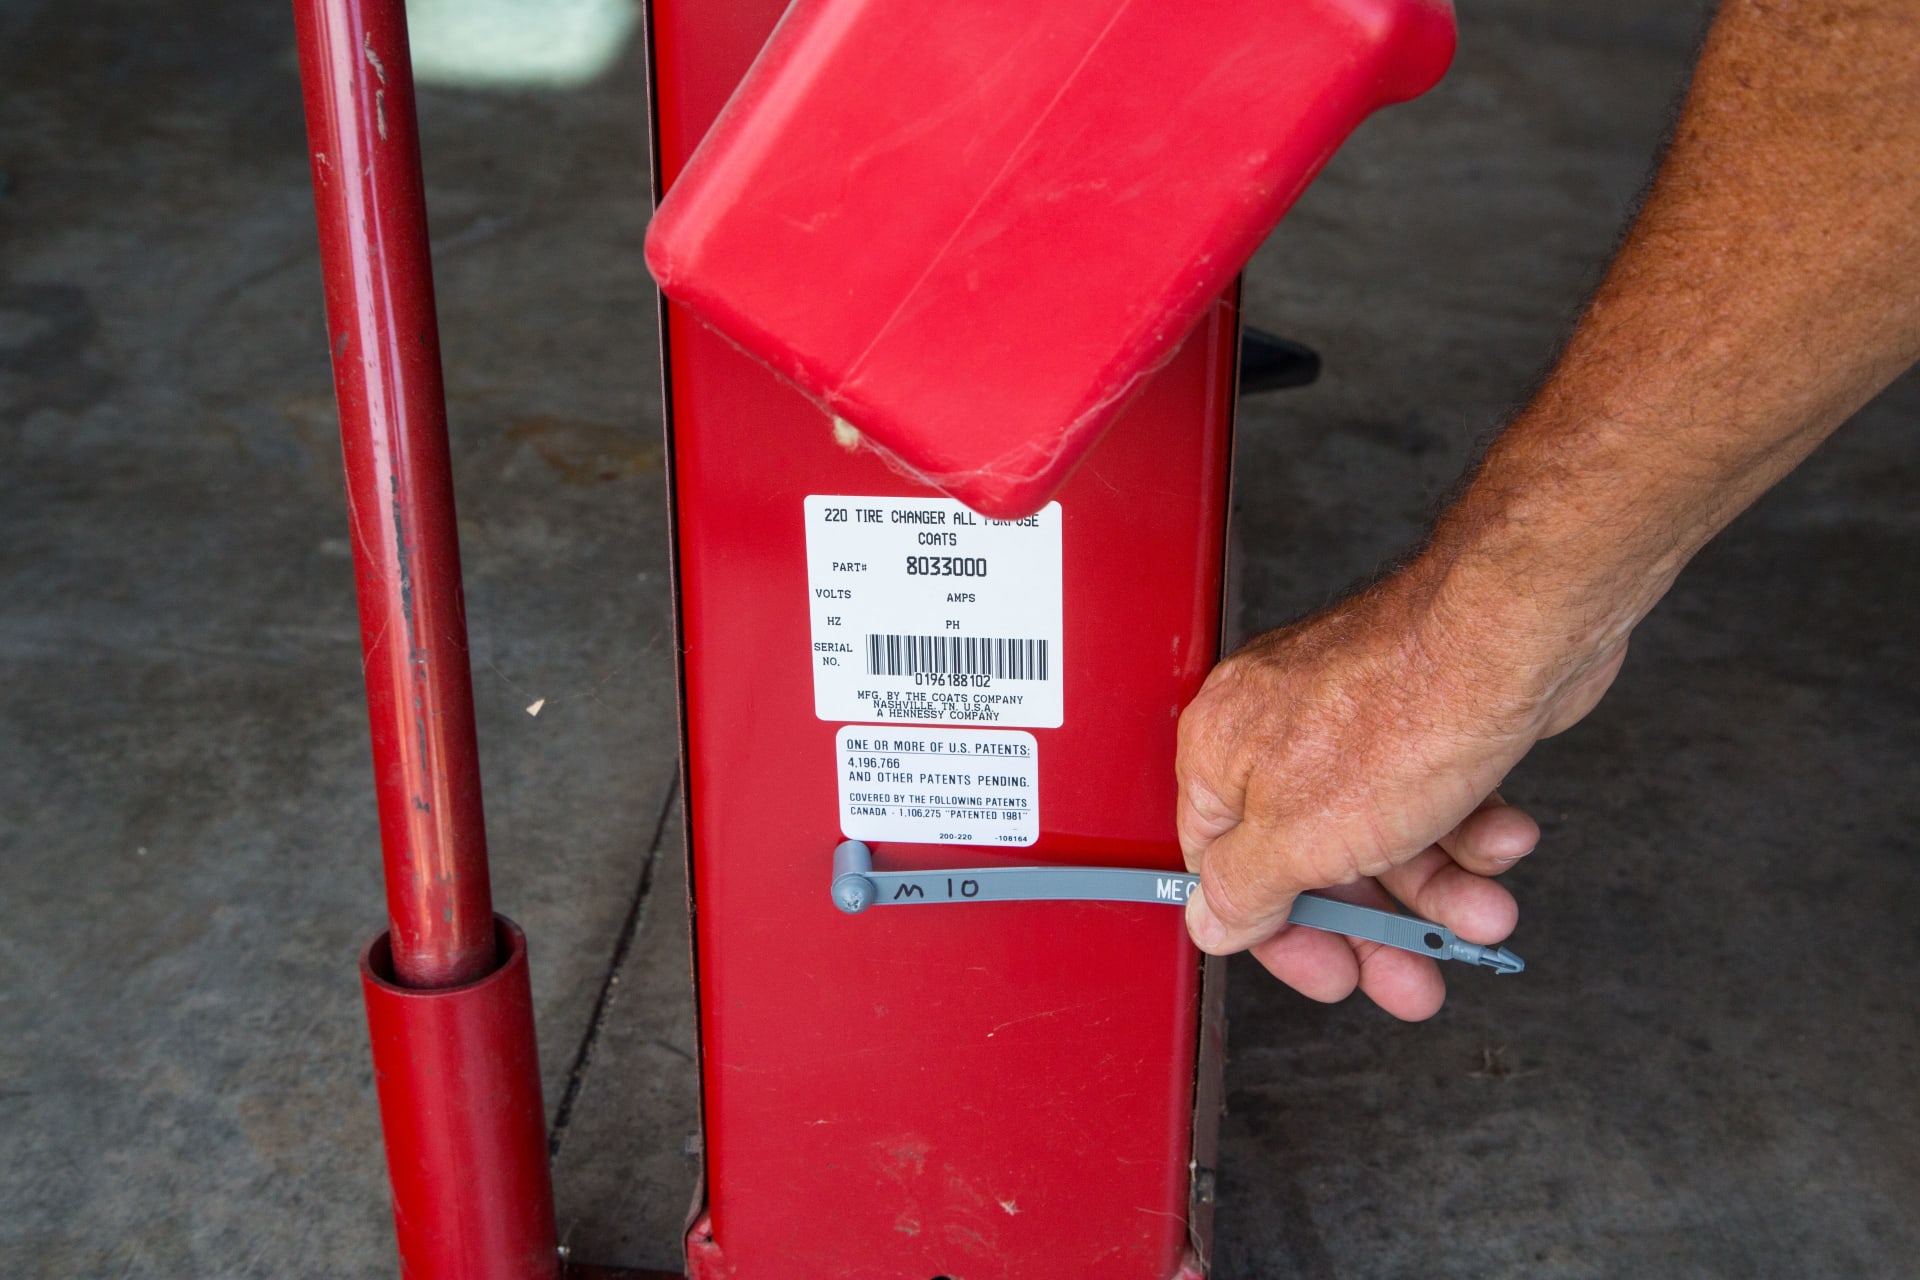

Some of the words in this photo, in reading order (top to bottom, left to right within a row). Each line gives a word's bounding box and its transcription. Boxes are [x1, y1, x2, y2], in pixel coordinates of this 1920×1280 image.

[824, 508, 847, 522] 220
[856, 509, 883, 523] TIRE
[891, 511, 946, 524] CHANGER
[953, 512, 977, 525] ALL
[918, 532, 957, 546] COATS
[832, 562, 868, 572] PART#
[906, 556, 987, 577] 8033000
[815, 589, 852, 599] VOLTS
[946, 593, 976, 603] AMPS
[827, 616, 842, 626] HZ
[946, 620, 960, 630] PH
[814, 643, 853, 653] SERIAL
[823, 657, 840, 666] NO.
[915, 673, 991, 688] 0196188102
[857, 690, 882, 700] MFG.
[887, 691, 900, 700] BY
[905, 692, 927, 701] THE
[932, 693, 968, 702] COATS
[973, 694, 1024, 704] COMPANY
[877, 709, 884, 717] A
[889, 709, 945, 719] HENNESSY
[950, 711, 1000, 721] COMPANY
[847, 739, 869, 750] ONE
[874, 740, 888, 751] OR
[894, 741, 925, 752] MORE
[930, 742, 943, 752] OF
[949, 743, 971, 754] U.S.
[975, 744, 1030, 755] PATENTS:
[849, 772, 871, 782] AND
[877, 772, 913, 783] OTHER
[920, 774, 971, 786] PATENTS
[978, 776, 1030, 787] PENDING.
[849, 793, 890, 803] COVERED
[894, 794, 905, 803] BY
[909, 795, 926, 804] THE
[929, 796, 982, 806] FOLLOWING
[986, 798, 1027, 807] PATENTS
[850, 807, 887, 816] CANADA
[947, 878, 979, 897] 10
